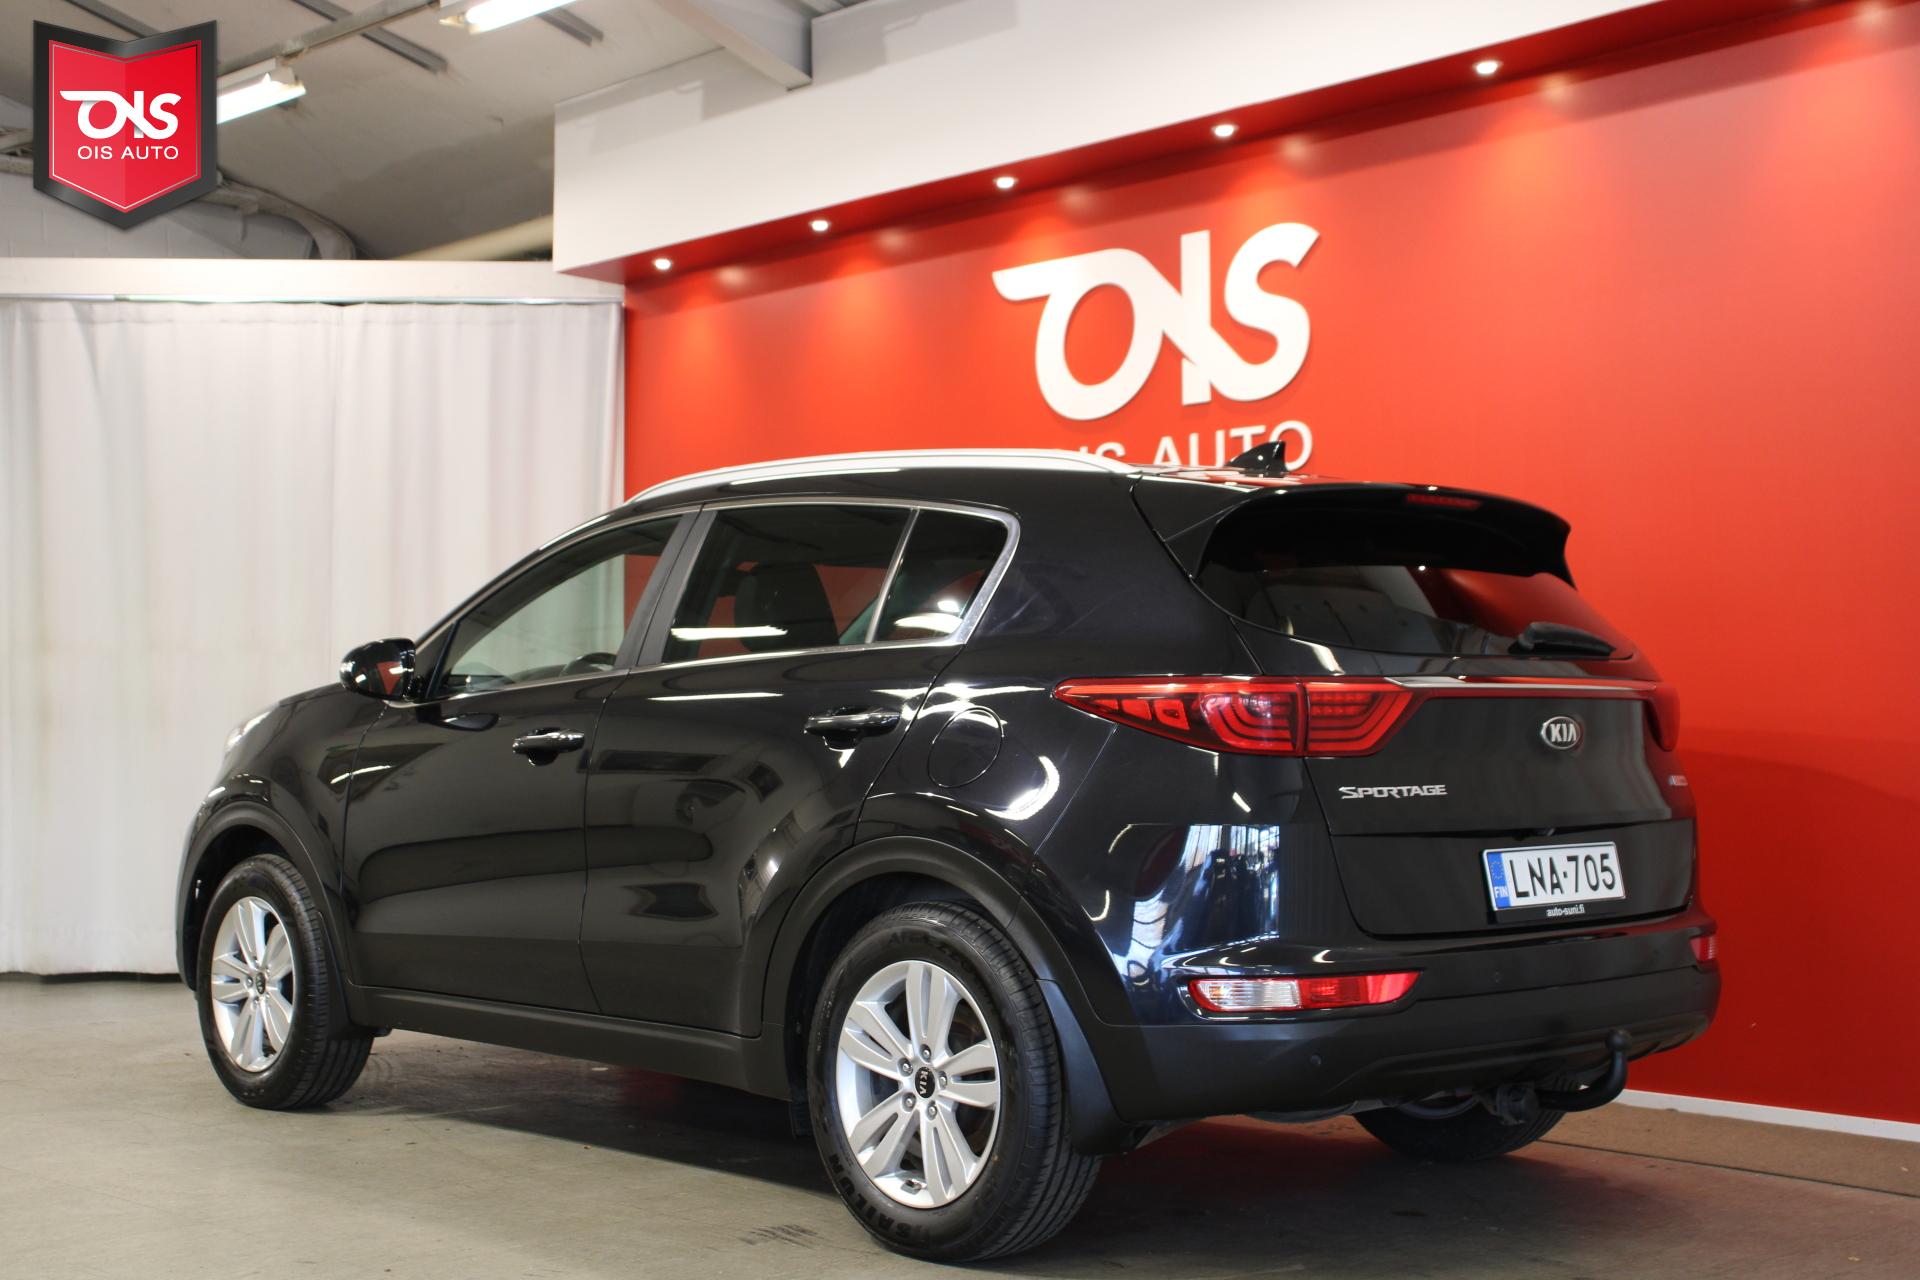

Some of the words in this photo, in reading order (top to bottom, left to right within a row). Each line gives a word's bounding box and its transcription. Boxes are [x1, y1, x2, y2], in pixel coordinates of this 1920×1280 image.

[1549, 723, 1577, 743] KIA
[1339, 784, 1448, 799] SPORTAGE
[1494, 885, 1509, 898] FIN
[919, 1070, 929, 1096] KIA
